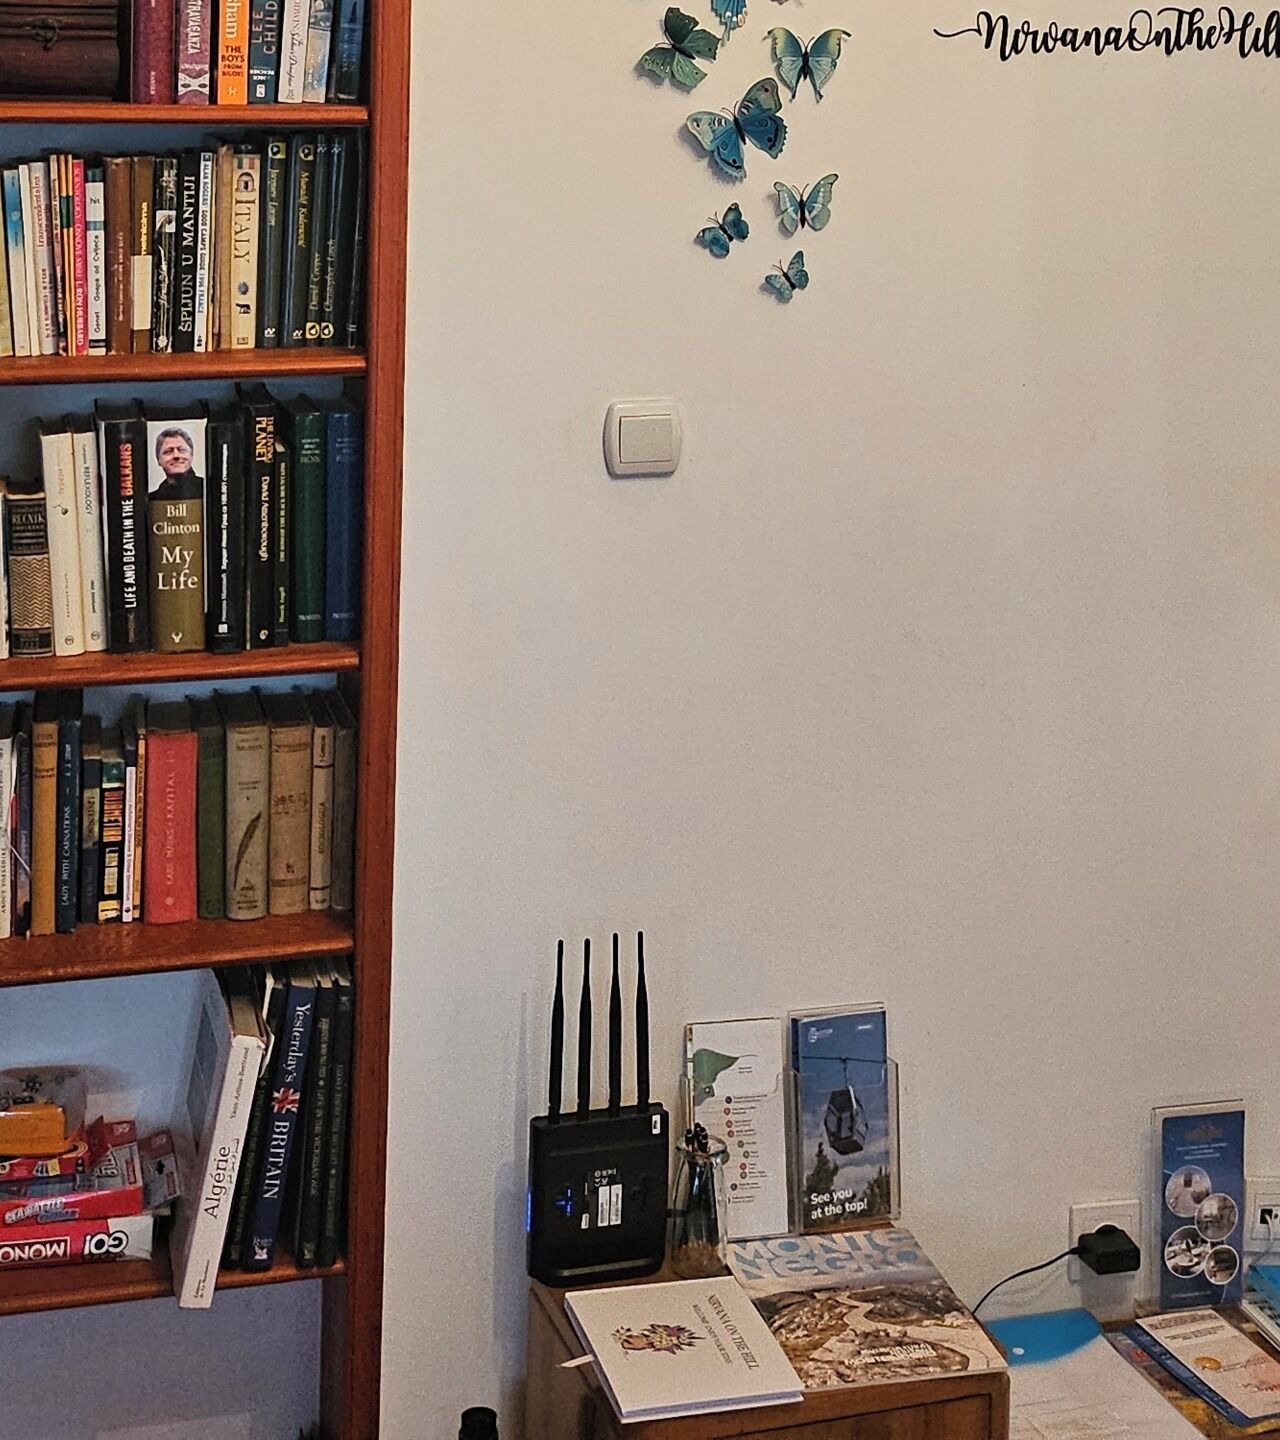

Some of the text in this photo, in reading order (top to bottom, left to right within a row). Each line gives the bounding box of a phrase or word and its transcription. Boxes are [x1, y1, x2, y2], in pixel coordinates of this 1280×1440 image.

[253, 10, 263, 43] LEE
[265, 0, 277, 54] CHILD
[222, 55, 244, 63] BOYS
[225, 46, 243, 54] THE
[234, 198, 256, 263] ITALY
[179, 175, 195, 332] ŠPIJUN U MANTIJI
[255, 417, 266, 463] PLANET
[119, 443, 137, 608] LIFE AND DEATH IN THE BALKANS
[166, 504, 187, 518] Bill
[152, 524, 200, 535] Clinton
[162, 546, 194, 568] My
[157, 570, 198, 590] Life
[281, 1000, 313, 1085] Yesterday's
[263, 1120, 291, 1200] BRITAIN
[209, 1145, 232, 1219] Algérie
[811, 1188, 852, 1205] See you
[811, 1199, 868, 1220] at the top!
[83, 1230, 128, 1257] GO!
